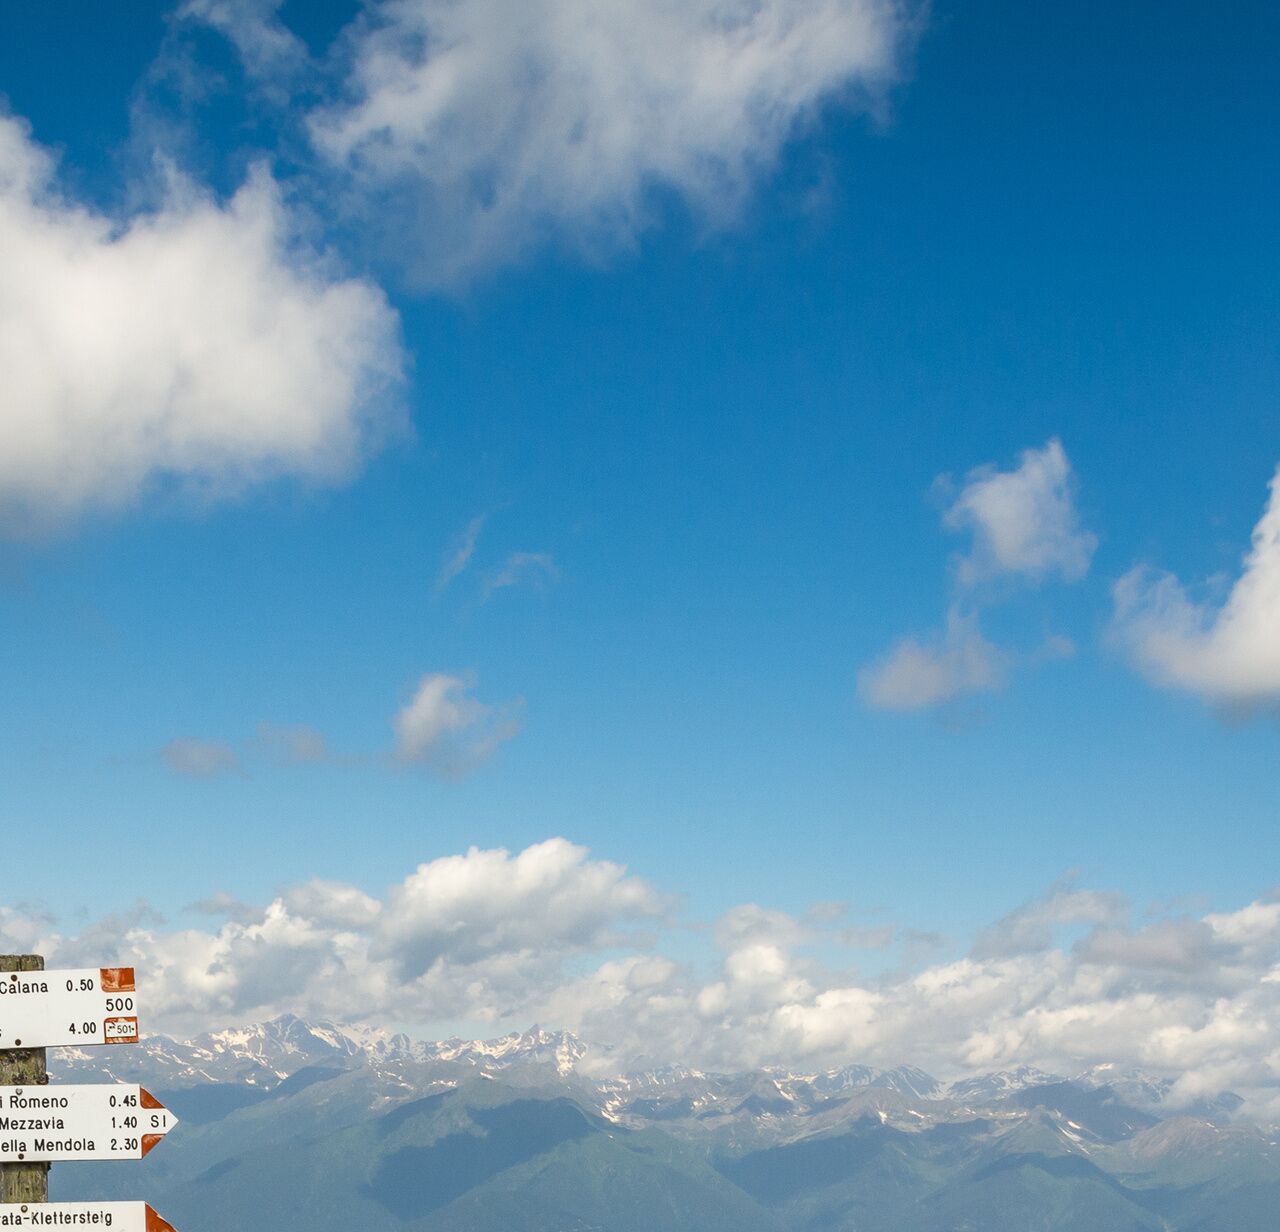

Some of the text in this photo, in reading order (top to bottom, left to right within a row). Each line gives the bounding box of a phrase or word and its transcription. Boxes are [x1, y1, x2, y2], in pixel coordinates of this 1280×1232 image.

[65, 978, 93, 991] 0.50
[105, 997, 133, 1011] 500
[68, 1021, 96, 1034] 4.00
[9, 1095, 68, 1108] Romeno
[109, 1094, 136, 1107] 0.45
[111, 1116, 137, 1128] 1.40
[34, 1137, 95, 1151] Mendola
[110, 1137, 138, 1150] 2.30
